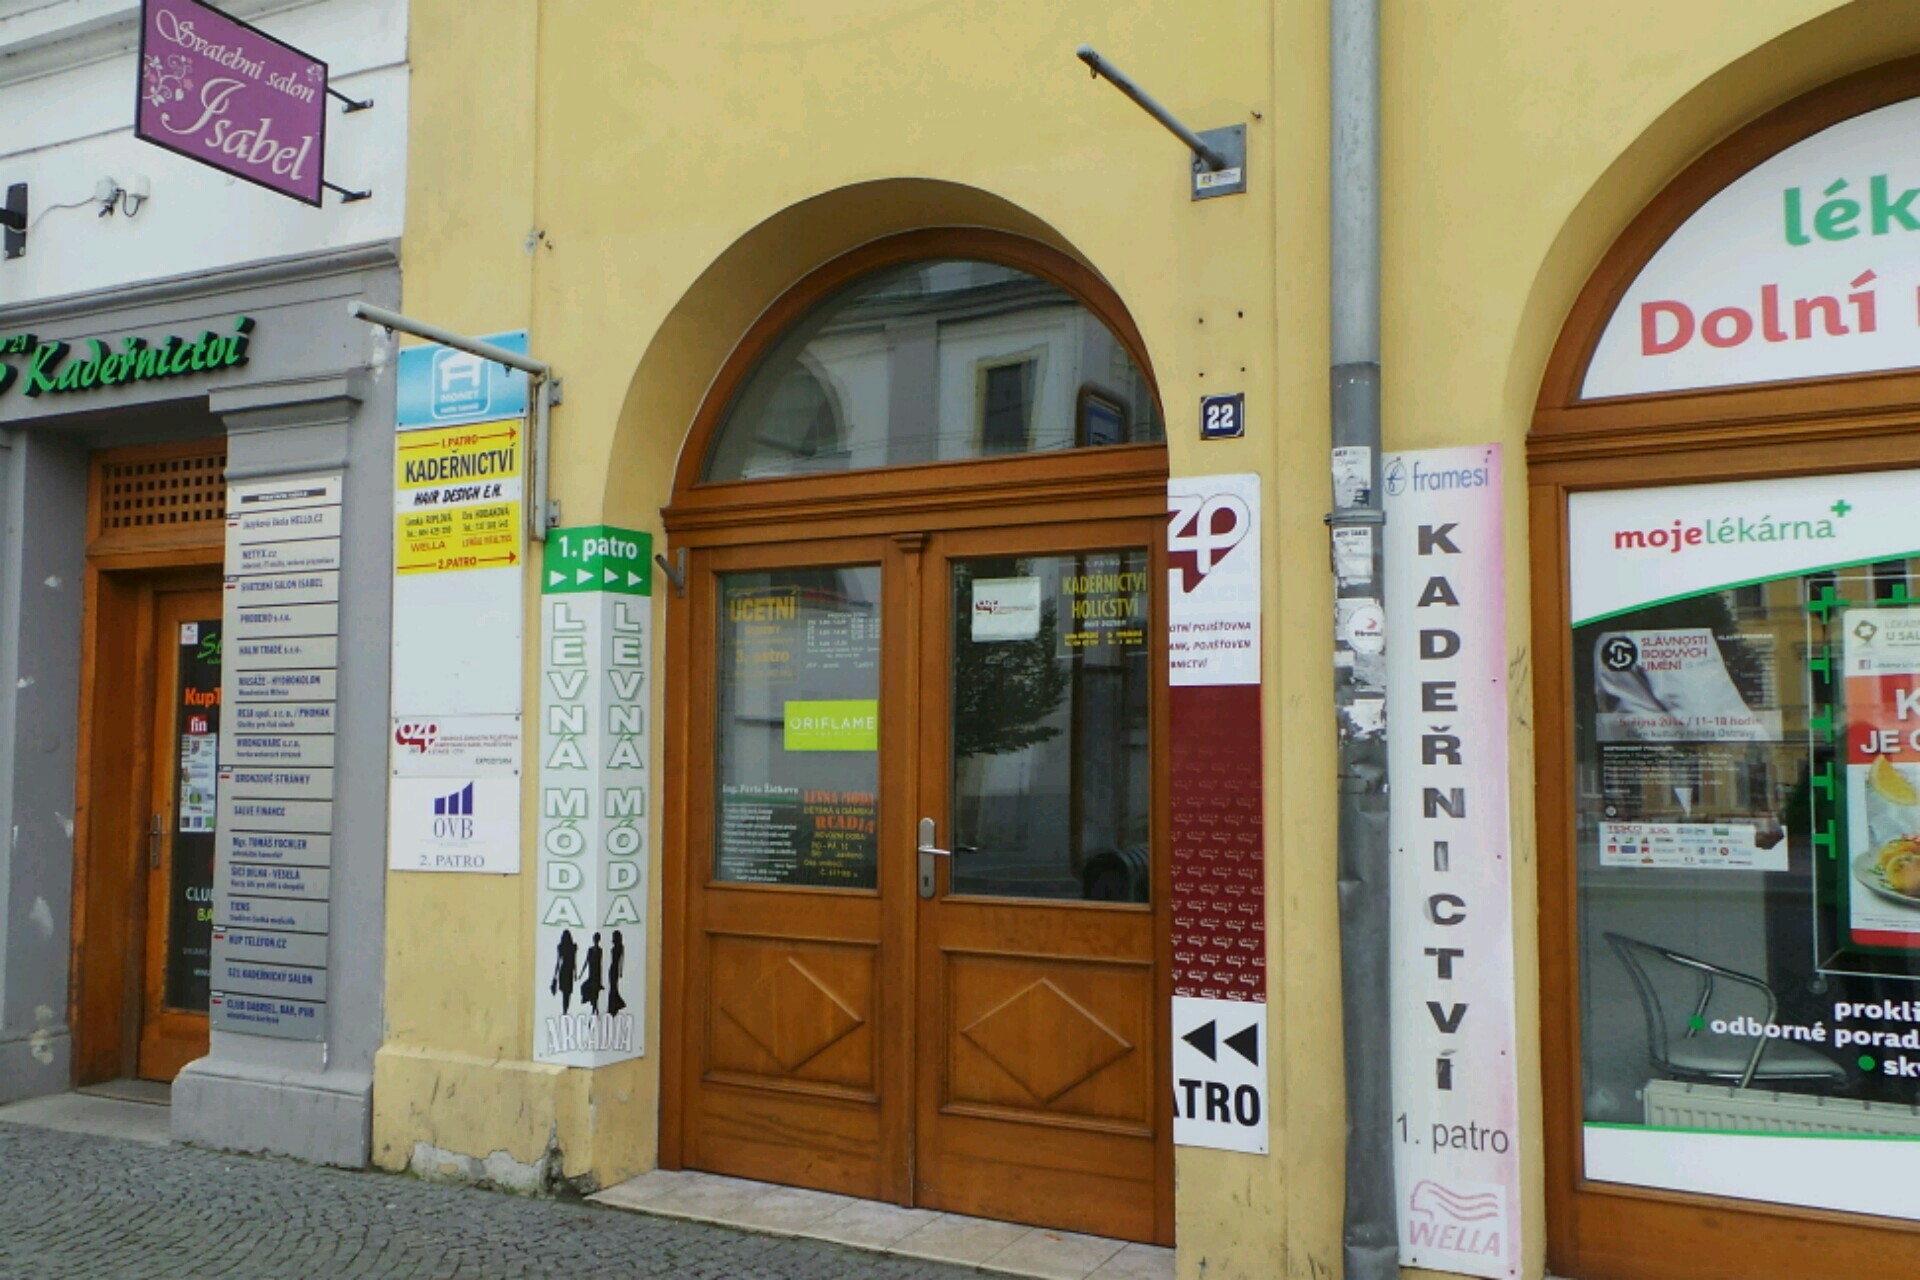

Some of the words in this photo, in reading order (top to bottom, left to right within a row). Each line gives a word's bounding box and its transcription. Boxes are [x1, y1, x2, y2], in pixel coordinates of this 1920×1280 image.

[156, 9, 265, 80] Svatební
[266, 69, 315, 104] salon
[161, 77, 314, 182] Isabel
[1641, 268, 1877, 356] Dolní
[22, 315, 250, 395] Kadeřnictví
[1207, 404, 1234, 430] 22
[405, 441, 516, 483] KADEŘNICTVÍ
[1413, 457, 1488, 491] framesi
[559, 536, 578, 558] 1.
[583, 537, 637, 562] patro
[1062, 567, 1147, 595] KADEŘNICTVÍ
[1072, 592, 1139, 619] HOLIČSTVÍ
[545, 601, 589, 770] LEVNÁ
[607, 601, 646, 770] LEVNÁ
[191, 716, 207, 732] fin
[789, 716, 875, 730] ORIFLAME
[1859, 729, 1901, 754] JE
[1416, 522, 1468, 1092] KADEŘNICTVÍ
[433, 817, 474, 839] OVB
[435, 854, 485, 868] PATRO
[541, 787, 589, 929] MÓDA
[603, 787, 646, 928] MÓDA
[1710, 1015, 1826, 1043] odborné
[1173, 1078, 1261, 1127] TRO
[1397, 1112, 1420, 1145] 1.
[1432, 1120, 1509, 1155] patro
[1409, 1219, 1500, 1258] WELLA
